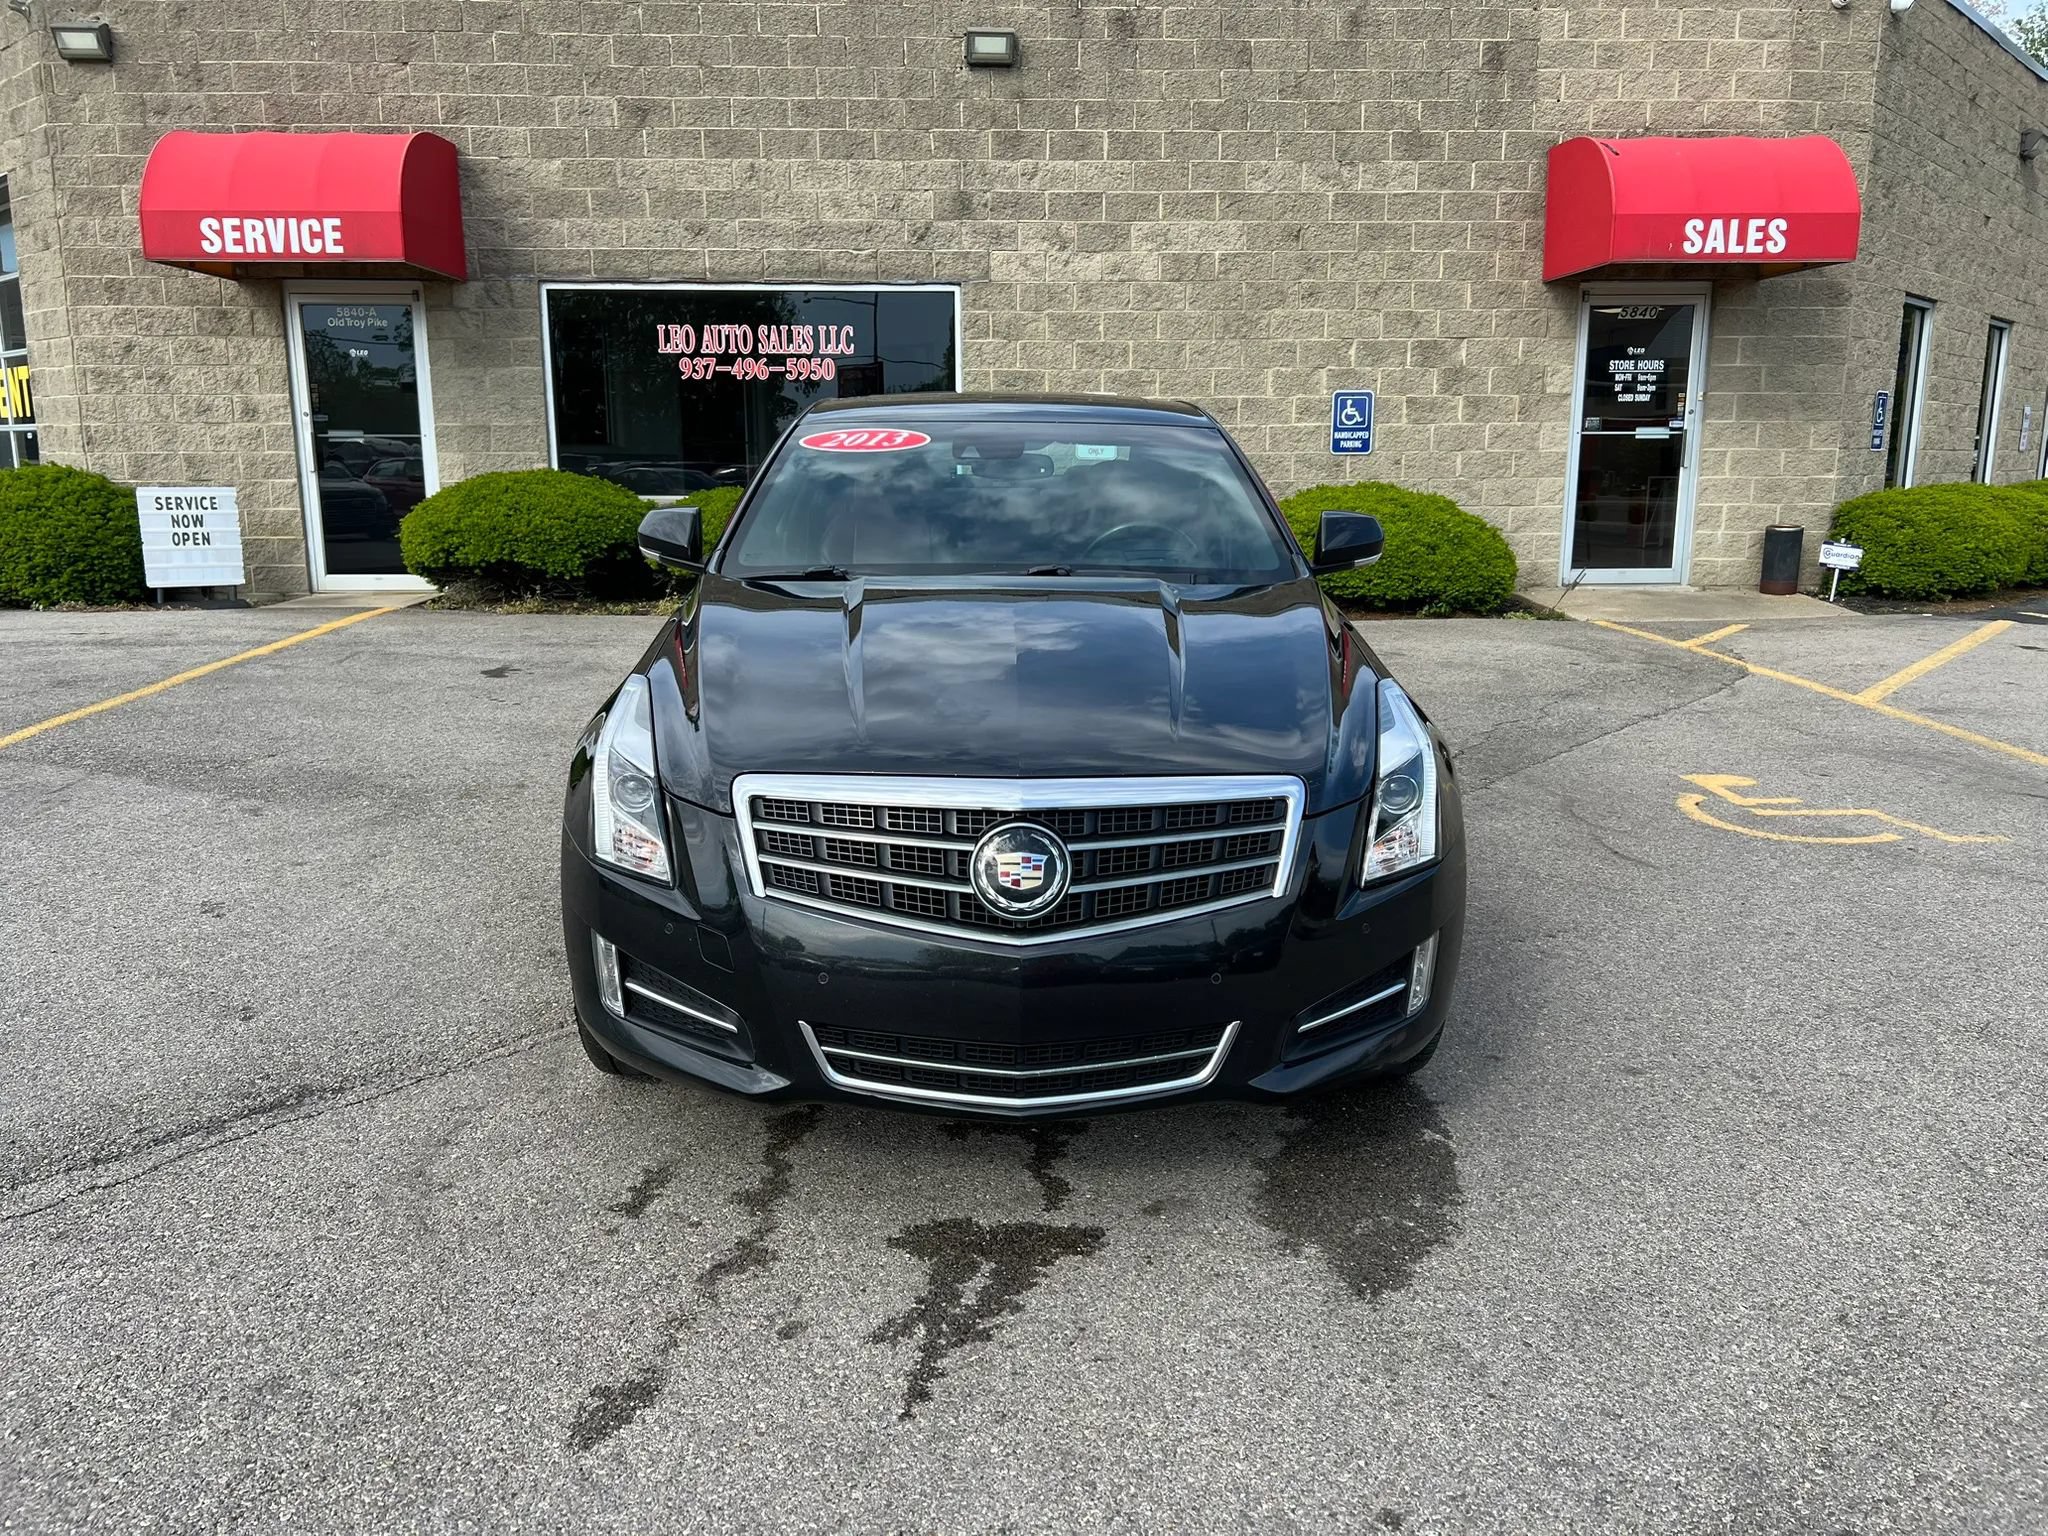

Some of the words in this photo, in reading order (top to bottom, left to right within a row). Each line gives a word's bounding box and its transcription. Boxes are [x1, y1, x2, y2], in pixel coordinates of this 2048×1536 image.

[200, 217, 344, 254] SERVICE
[1683, 218, 1788, 254] SALES
[336, 307, 377, 317] 5840-A
[1620, 306, 1658, 318] 5840
[327, 317, 345, 327] Old
[346, 318, 365, 329] Troy
[367, 318, 388, 327] Pike
[657, 324, 696, 354] LEO
[700, 324, 754, 354] AUTO
[758, 325, 814, 354] SALES
[818, 325, 855, 354] LLC
[679, 357, 836, 380] 937-496-5950
[1609, 360, 1635, 370] STORE
[1637, 360, 1665, 370] HOURS
[1614, 383, 1623, 391] SAT
[1617, 393, 1634, 402] CLOSED
[1634, 393, 1651, 402] SUNDAY
[820, 432, 909, 447] 2013
[1334, 431, 1369, 439] HANDICAPPED
[1340, 440, 1362, 448] PARKING
[154, 496, 218, 511] SERVICE
[171, 514, 204, 528] NOW
[172, 532, 211, 546] OPEN
